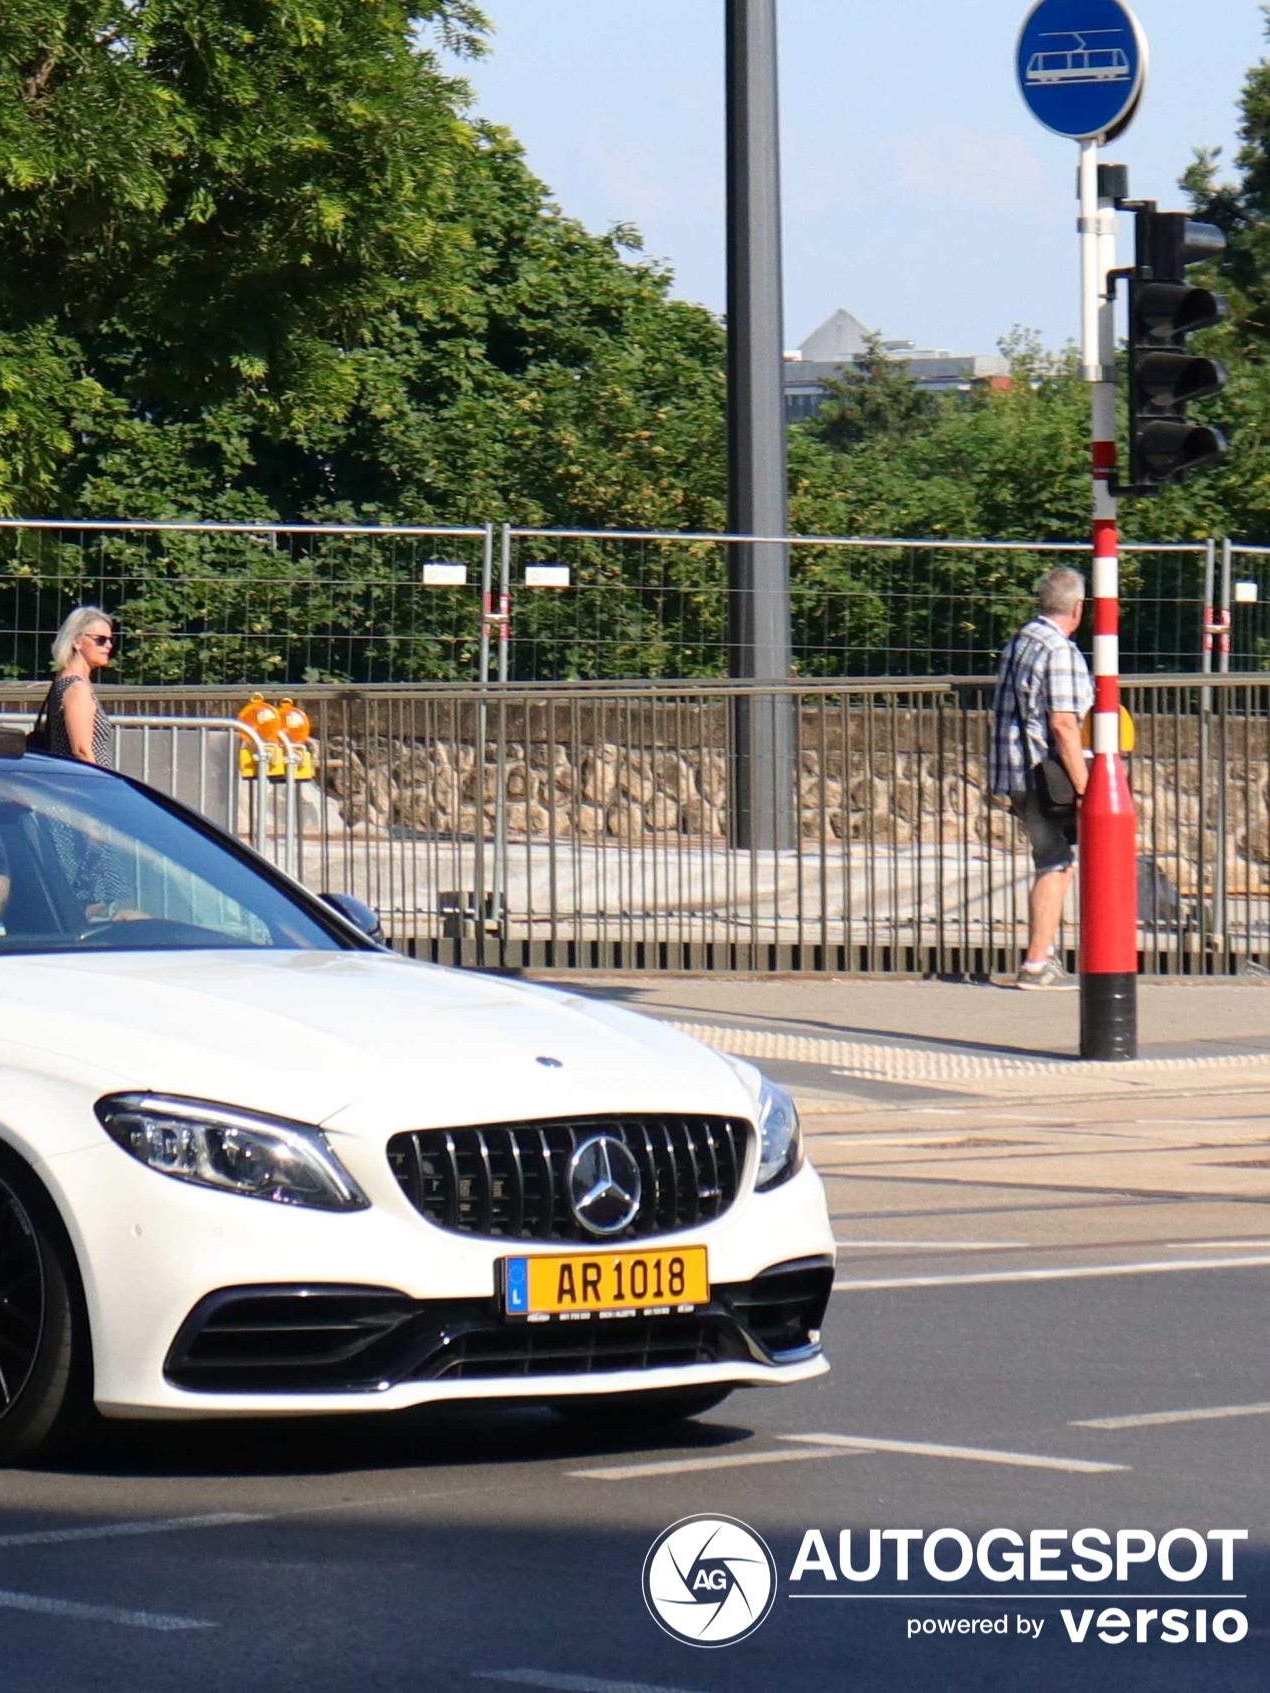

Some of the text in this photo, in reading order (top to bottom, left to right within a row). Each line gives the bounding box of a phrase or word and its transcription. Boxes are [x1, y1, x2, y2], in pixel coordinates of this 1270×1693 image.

[556, 1258, 686, 1304] AR 1018
[512, 1289, 522, 1305] L
